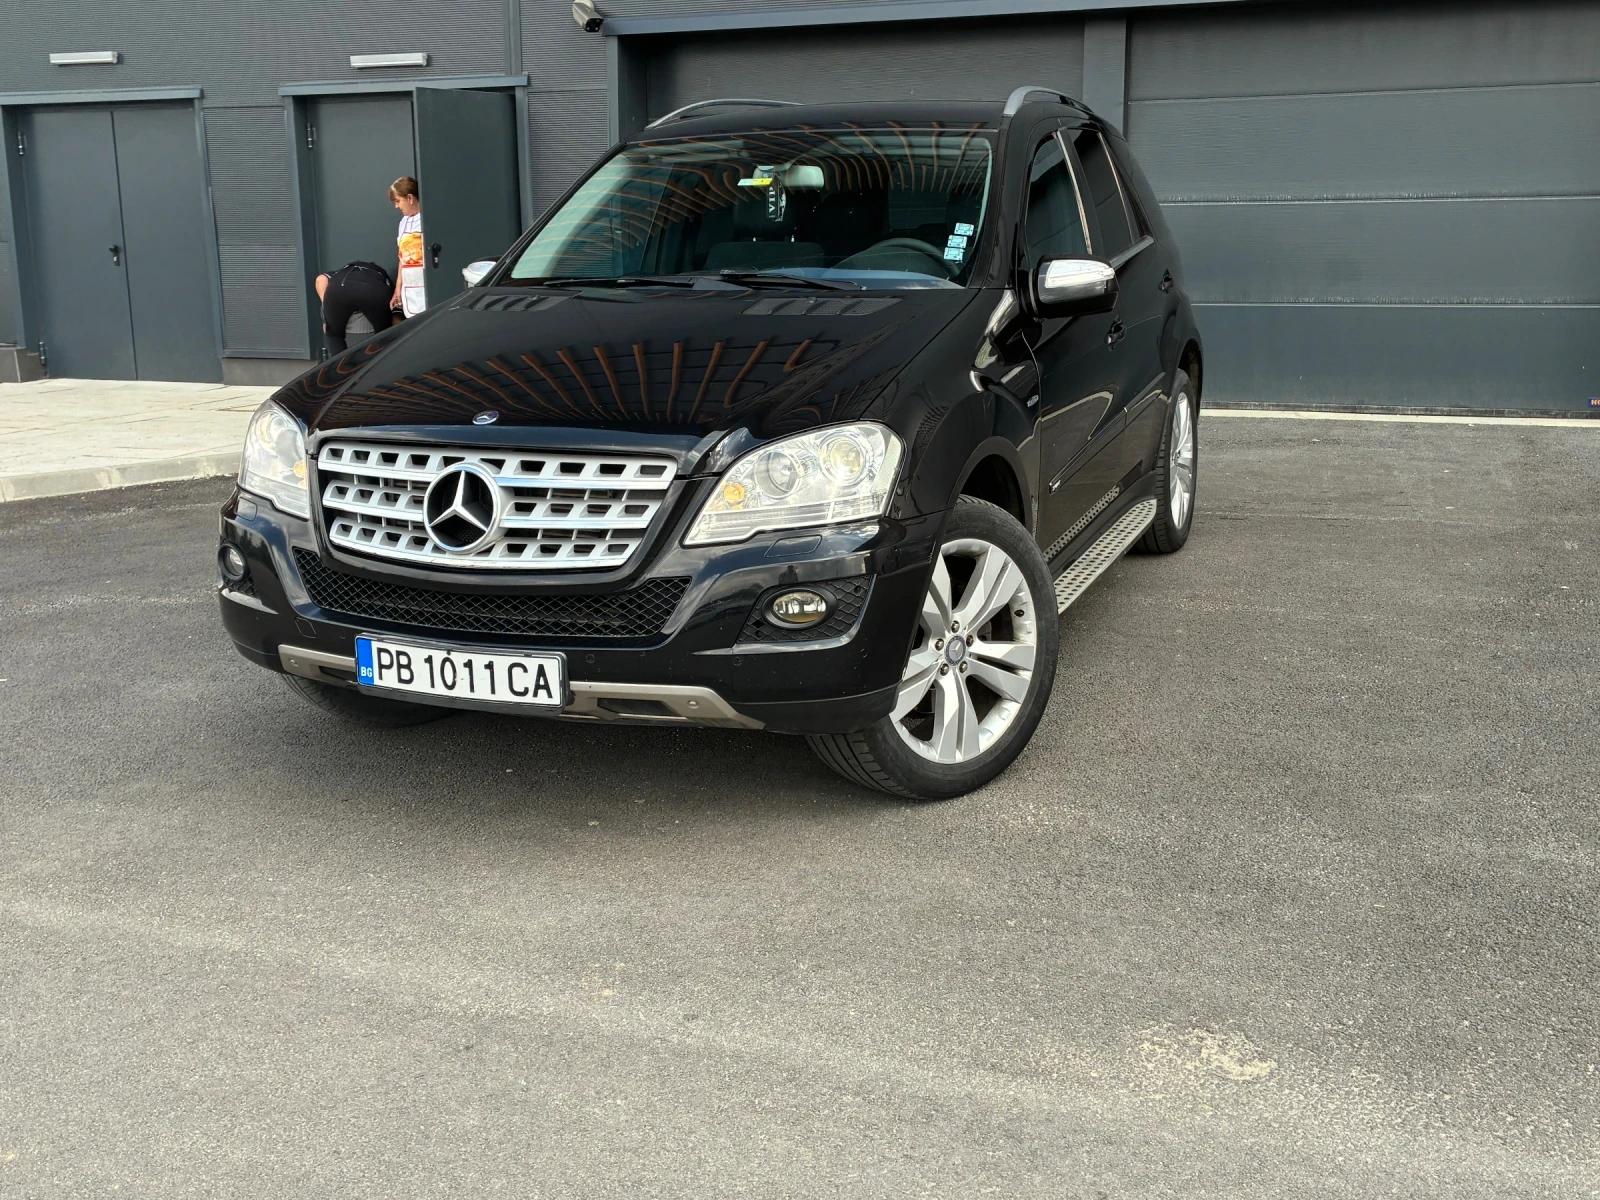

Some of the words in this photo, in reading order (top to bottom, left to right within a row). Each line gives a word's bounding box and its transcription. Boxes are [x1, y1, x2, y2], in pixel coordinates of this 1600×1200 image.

[360, 666, 373, 678] BG
[376, 646, 415, 685] PB
[424, 654, 496, 695] 1011
[507, 662, 553, 699] CA
